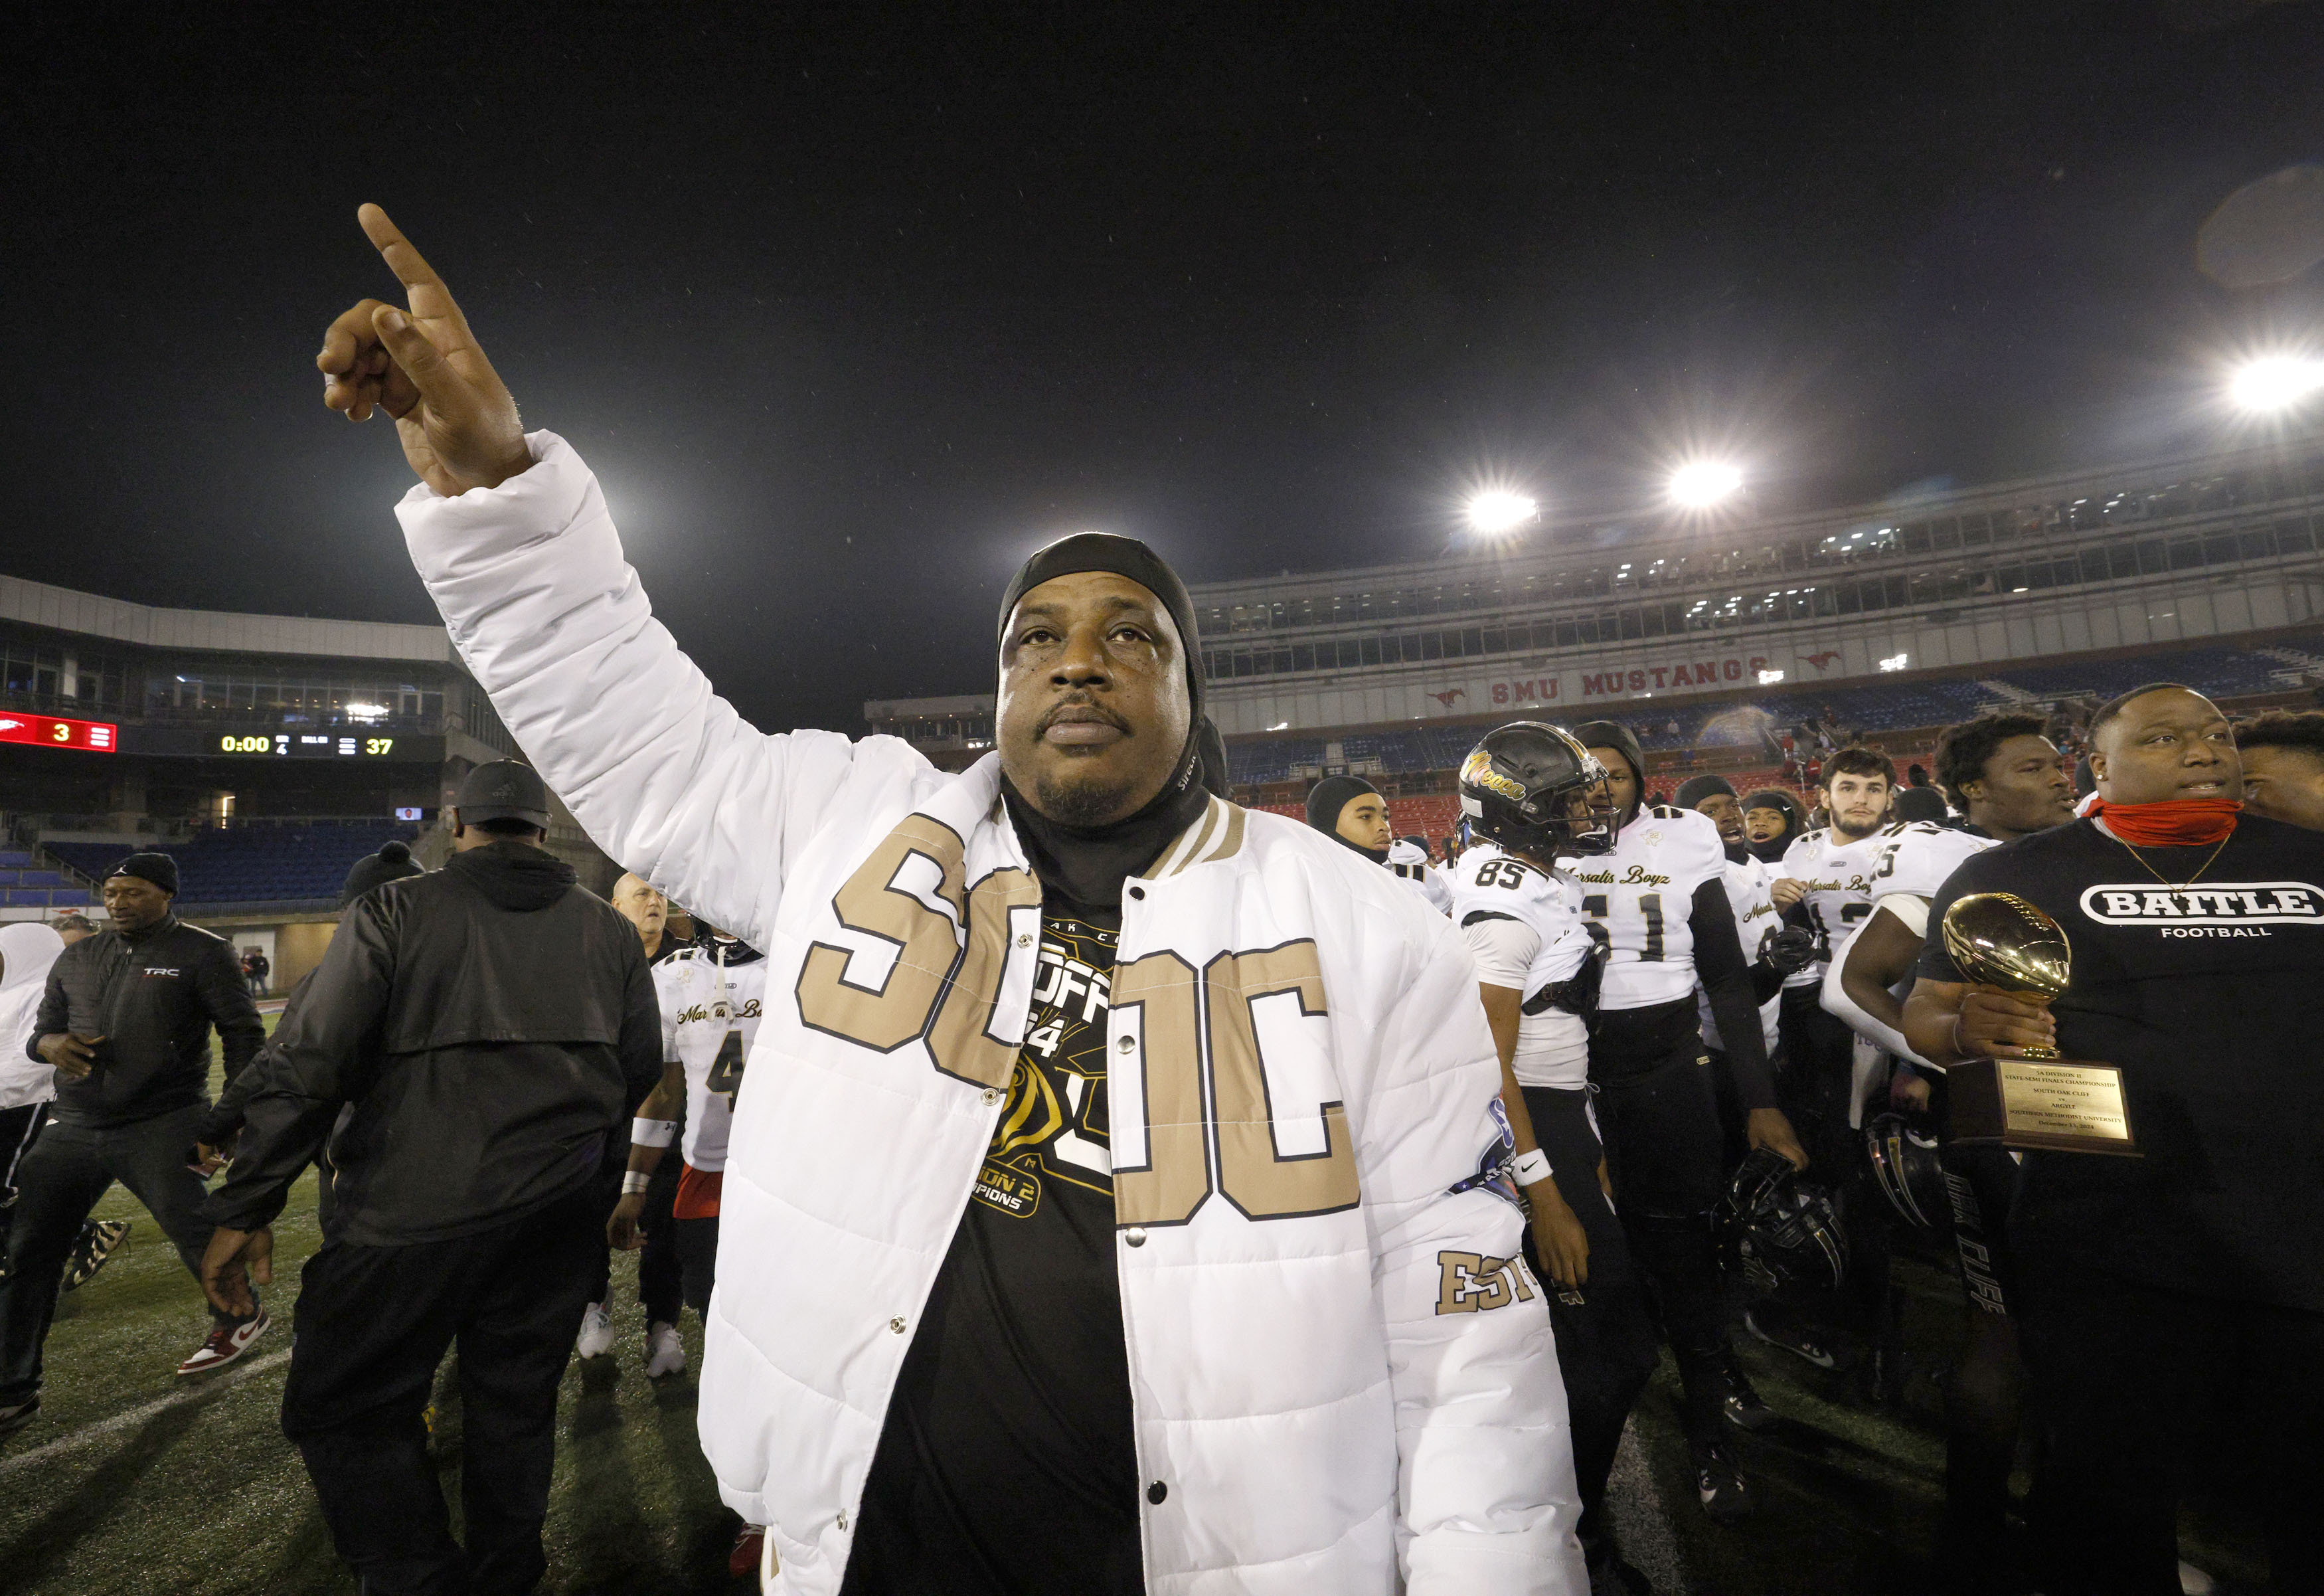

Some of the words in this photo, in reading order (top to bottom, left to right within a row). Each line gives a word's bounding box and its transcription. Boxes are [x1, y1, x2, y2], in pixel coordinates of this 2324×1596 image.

[1492, 678, 1558, 704] SMU
[1583, 657, 1768, 695] MUSTANGS
[54, 724, 70, 741] 3
[221, 736, 270, 753] 0:00
[366, 739, 393, 754] 37
[1464, 750, 1527, 801] Mecca
[1475, 861, 1527, 891] 85
[1619, 865, 1671, 887] Boyz
[2102, 890, 2317, 916] BATTLE
[2161, 927, 2272, 938] FOOTBALL
[143, 968, 180, 977] TRC
[705, 1029, 745, 1113] 4
[2065, 1079, 2116, 1088] CHAMPIONSHIP
[972, 1182, 1023, 1211] PIONS
